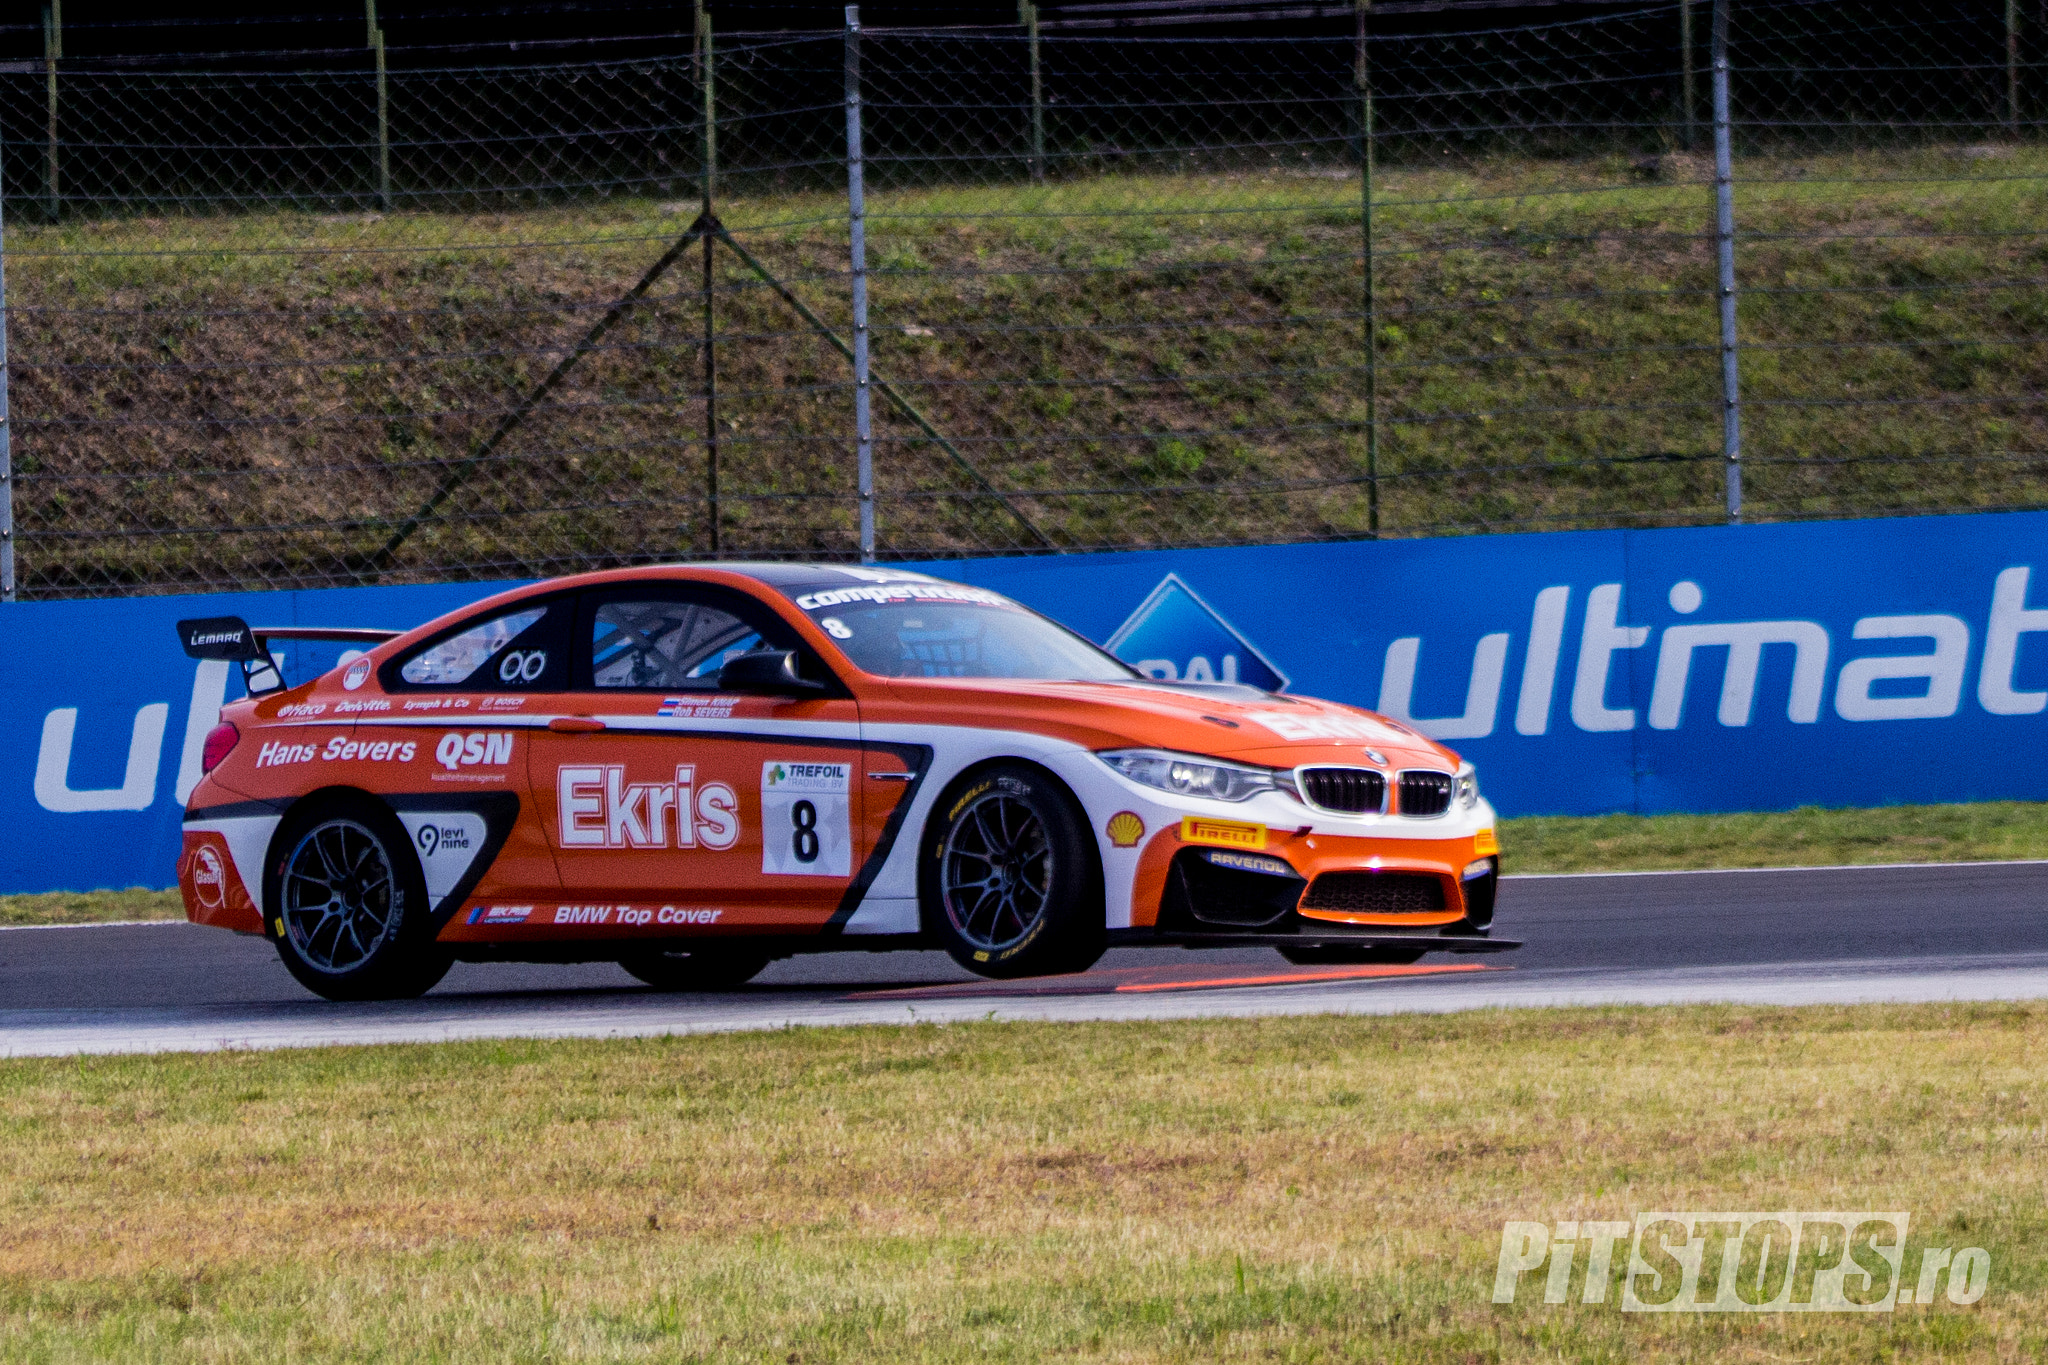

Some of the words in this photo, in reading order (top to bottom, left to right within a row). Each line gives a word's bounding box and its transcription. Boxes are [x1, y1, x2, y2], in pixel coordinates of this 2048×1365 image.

[821, 617, 853, 640] 8
[1378, 566, 2048, 740] ultimat
[672, 707, 693, 718] Rob
[693, 707, 732, 718] SEVERS
[255, 740, 317, 769] Hans
[321, 735, 417, 763] Severs
[436, 732, 513, 770] QSN
[789, 764, 844, 778] TREFOIL
[557, 764, 741, 851] Ekris
[441, 827, 464, 839] levi
[791, 799, 819, 864] 8
[1189, 821, 1257, 844] PIRELLI
[441, 838, 469, 849] nine
[1210, 852, 1285, 874] RAVENOL
[554, 905, 611, 924] BMW
[615, 906, 651, 926] Top
[657, 906, 722, 924] Cover
